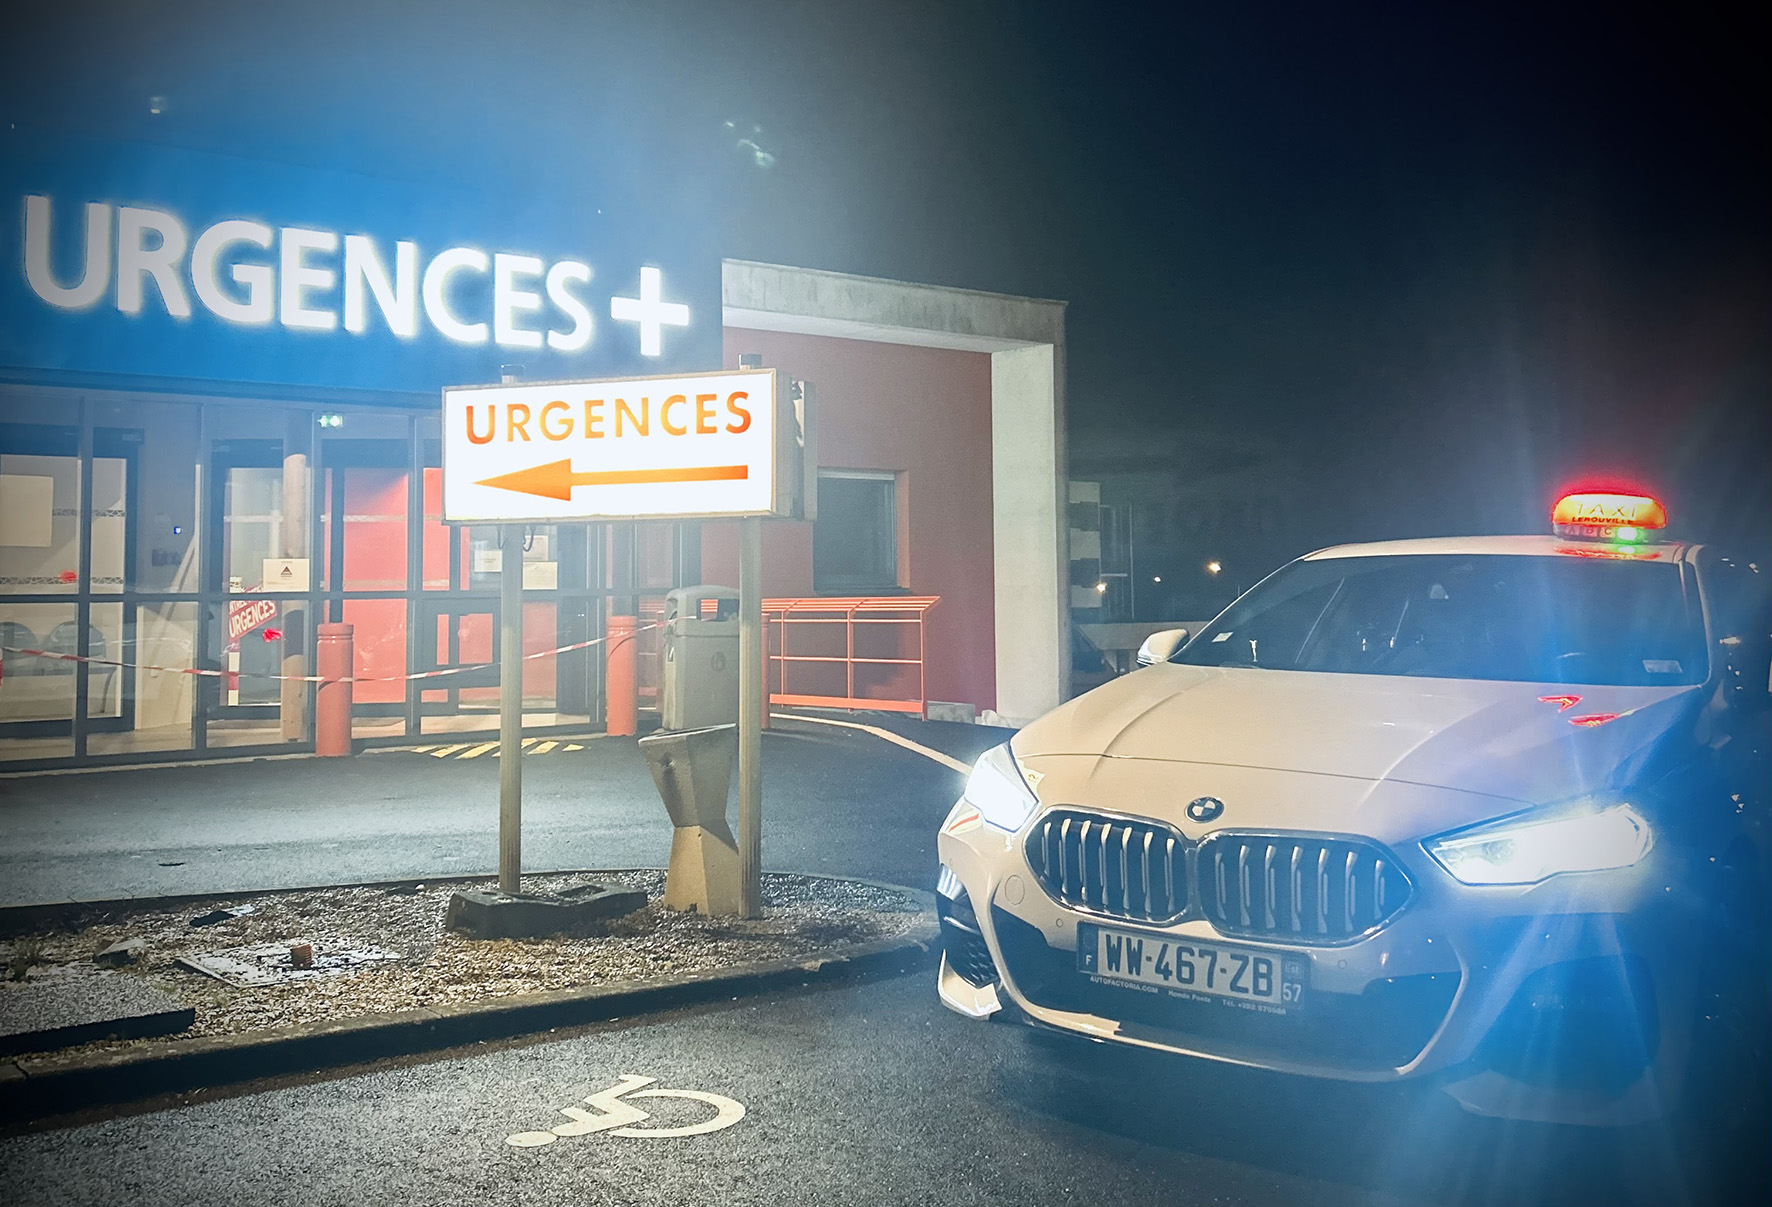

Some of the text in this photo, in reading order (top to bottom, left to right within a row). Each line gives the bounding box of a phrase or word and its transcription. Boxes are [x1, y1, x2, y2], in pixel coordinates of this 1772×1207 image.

[25, 195, 592, 350] URGENCES
[466, 391, 751, 444] URGENCES
[1576, 503, 1637, 517] TAXI
[1604, 526, 1612, 535] C
[229, 599, 276, 637] URGENCES
[1085, 954, 1093, 966] F
[1105, 934, 1273, 997] WW-467-ZB
[1089, 976, 1159, 993] AUTOFACTORIA.COM
[1282, 982, 1302, 1003] 57
